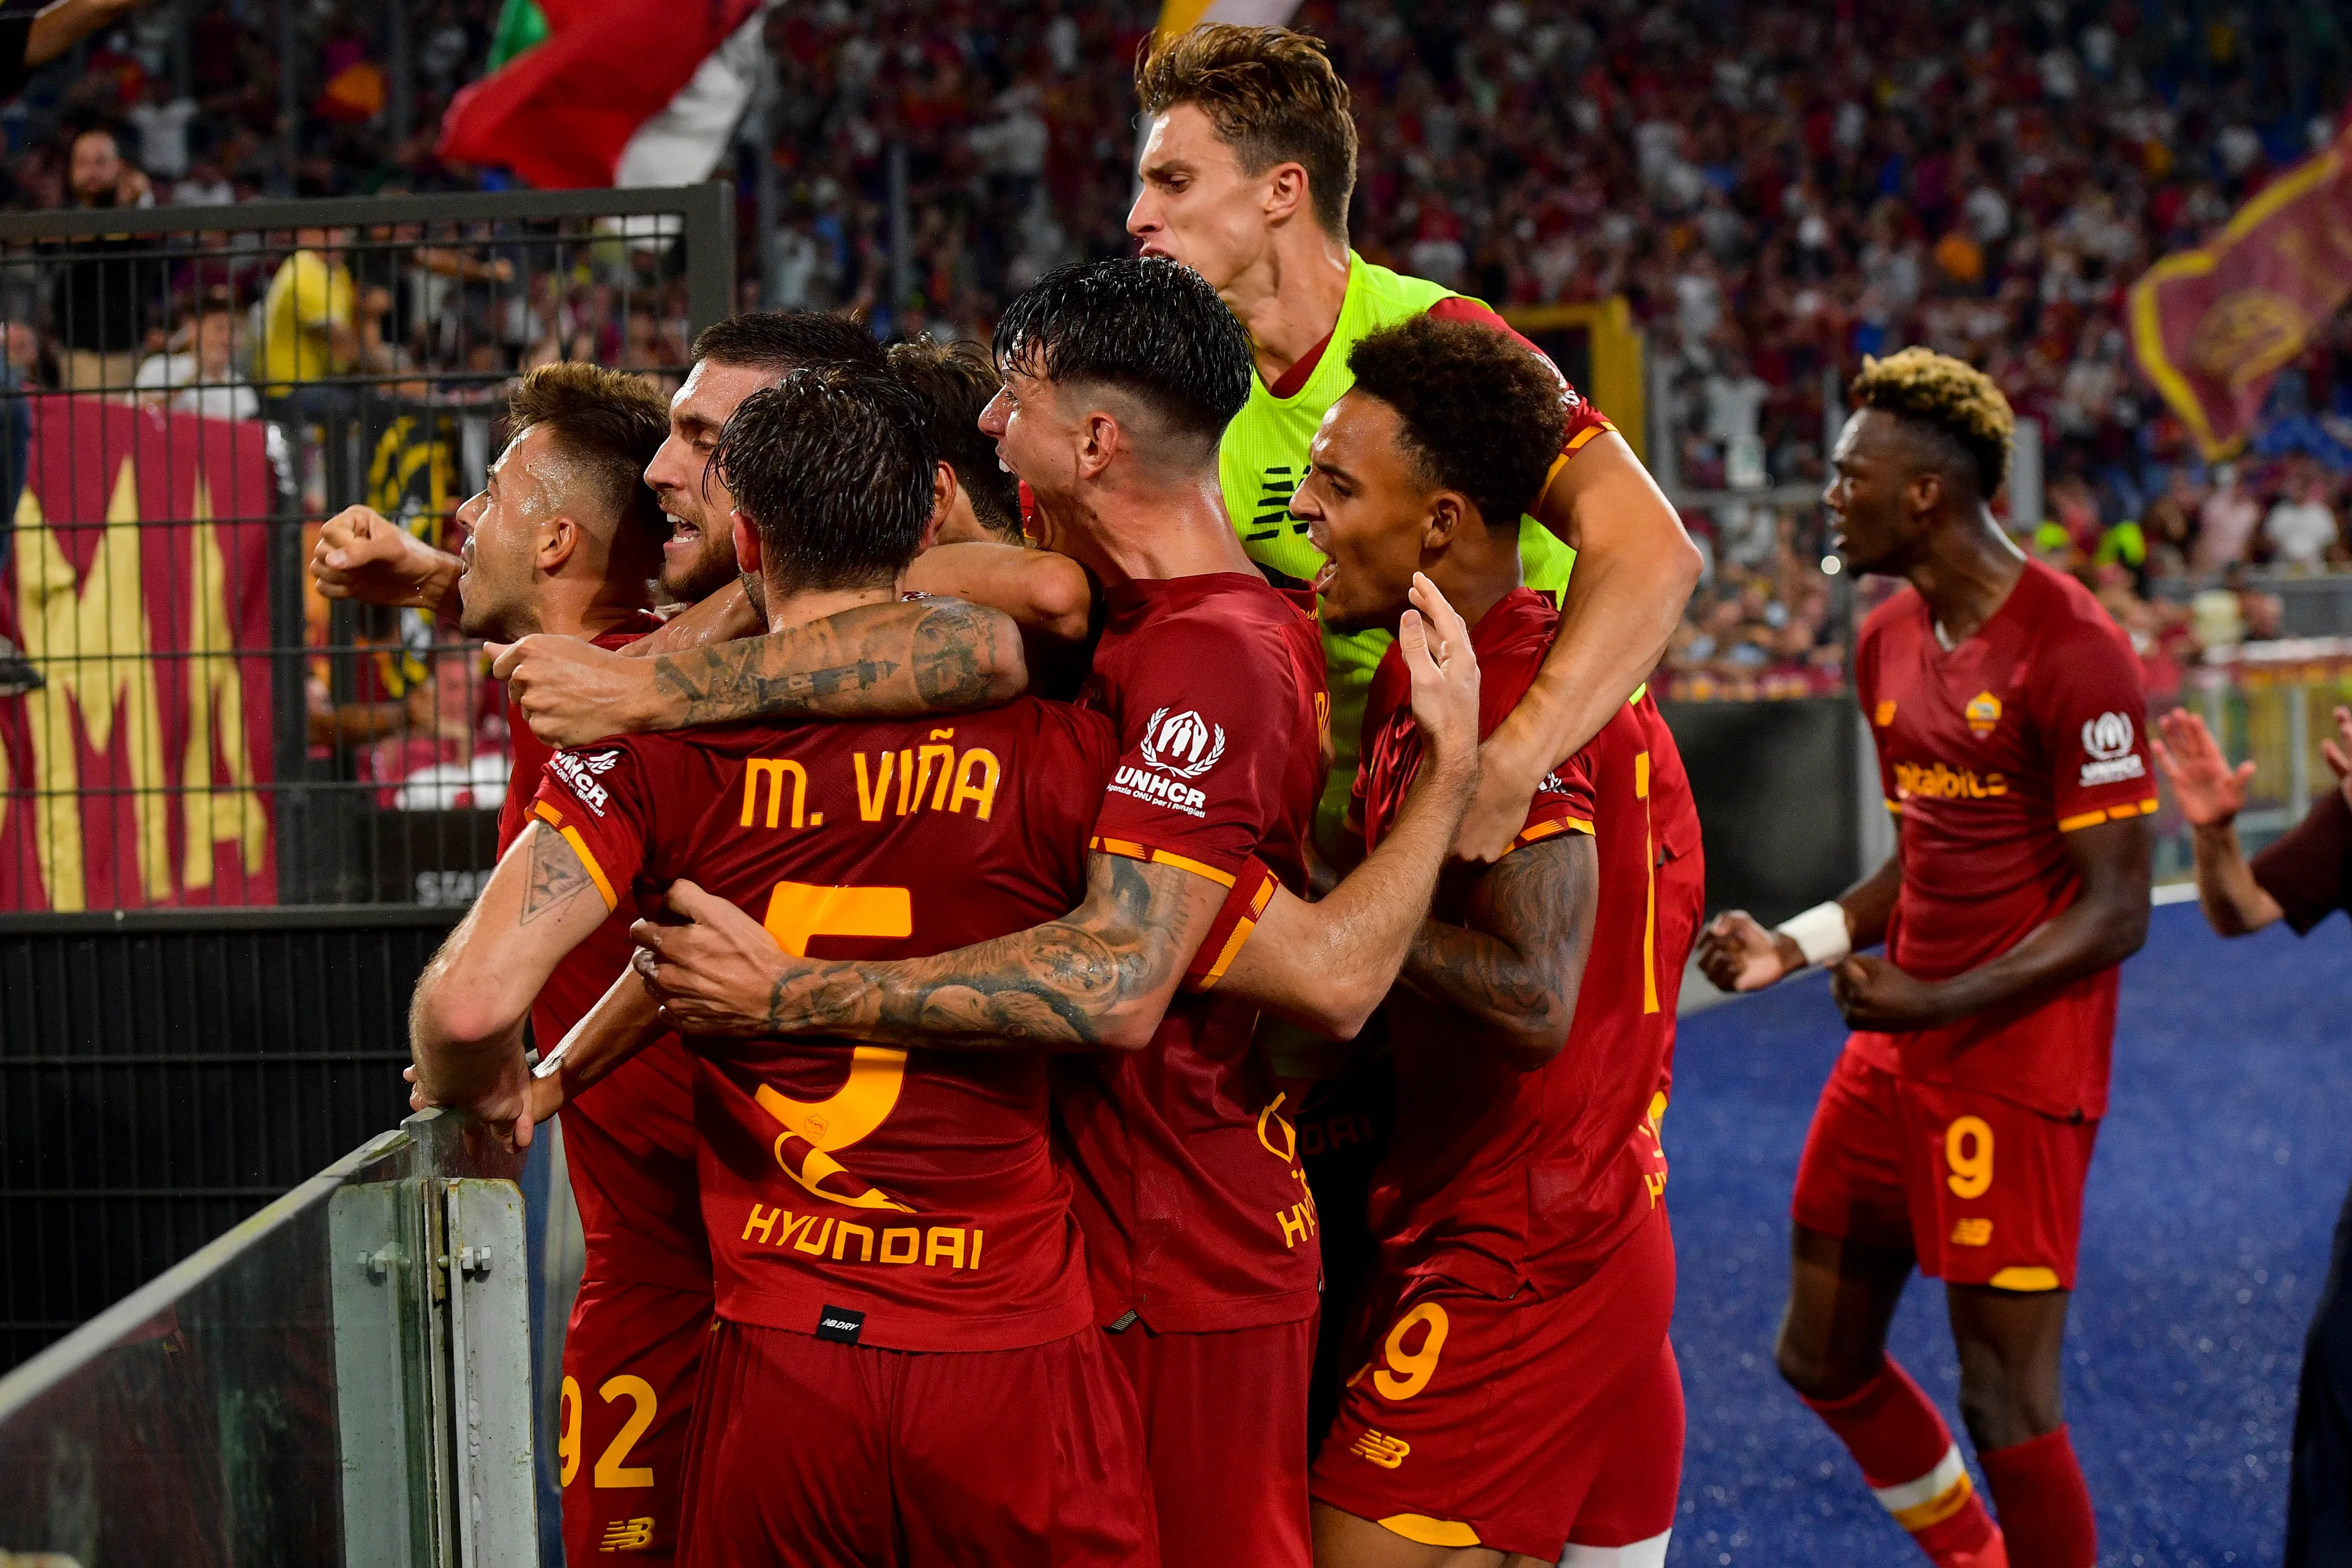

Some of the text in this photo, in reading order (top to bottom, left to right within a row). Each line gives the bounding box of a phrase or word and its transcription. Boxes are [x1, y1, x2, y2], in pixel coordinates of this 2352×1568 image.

[0, 453, 268, 913] MA
[1106, 783, 1132, 796] Agenzia
[1133, 790, 1153, 802] ONU
[1152, 797, 1168, 807] per
[1115, 765, 1206, 809] UNHCR
[753, 881, 913, 1152] 5
[1945, 1115, 1994, 1199] 9
[741, 1203, 984, 1270] HYUNDAI
[1346, 1302, 1449, 1401] 9
[559, 1374, 658, 1488] 92
